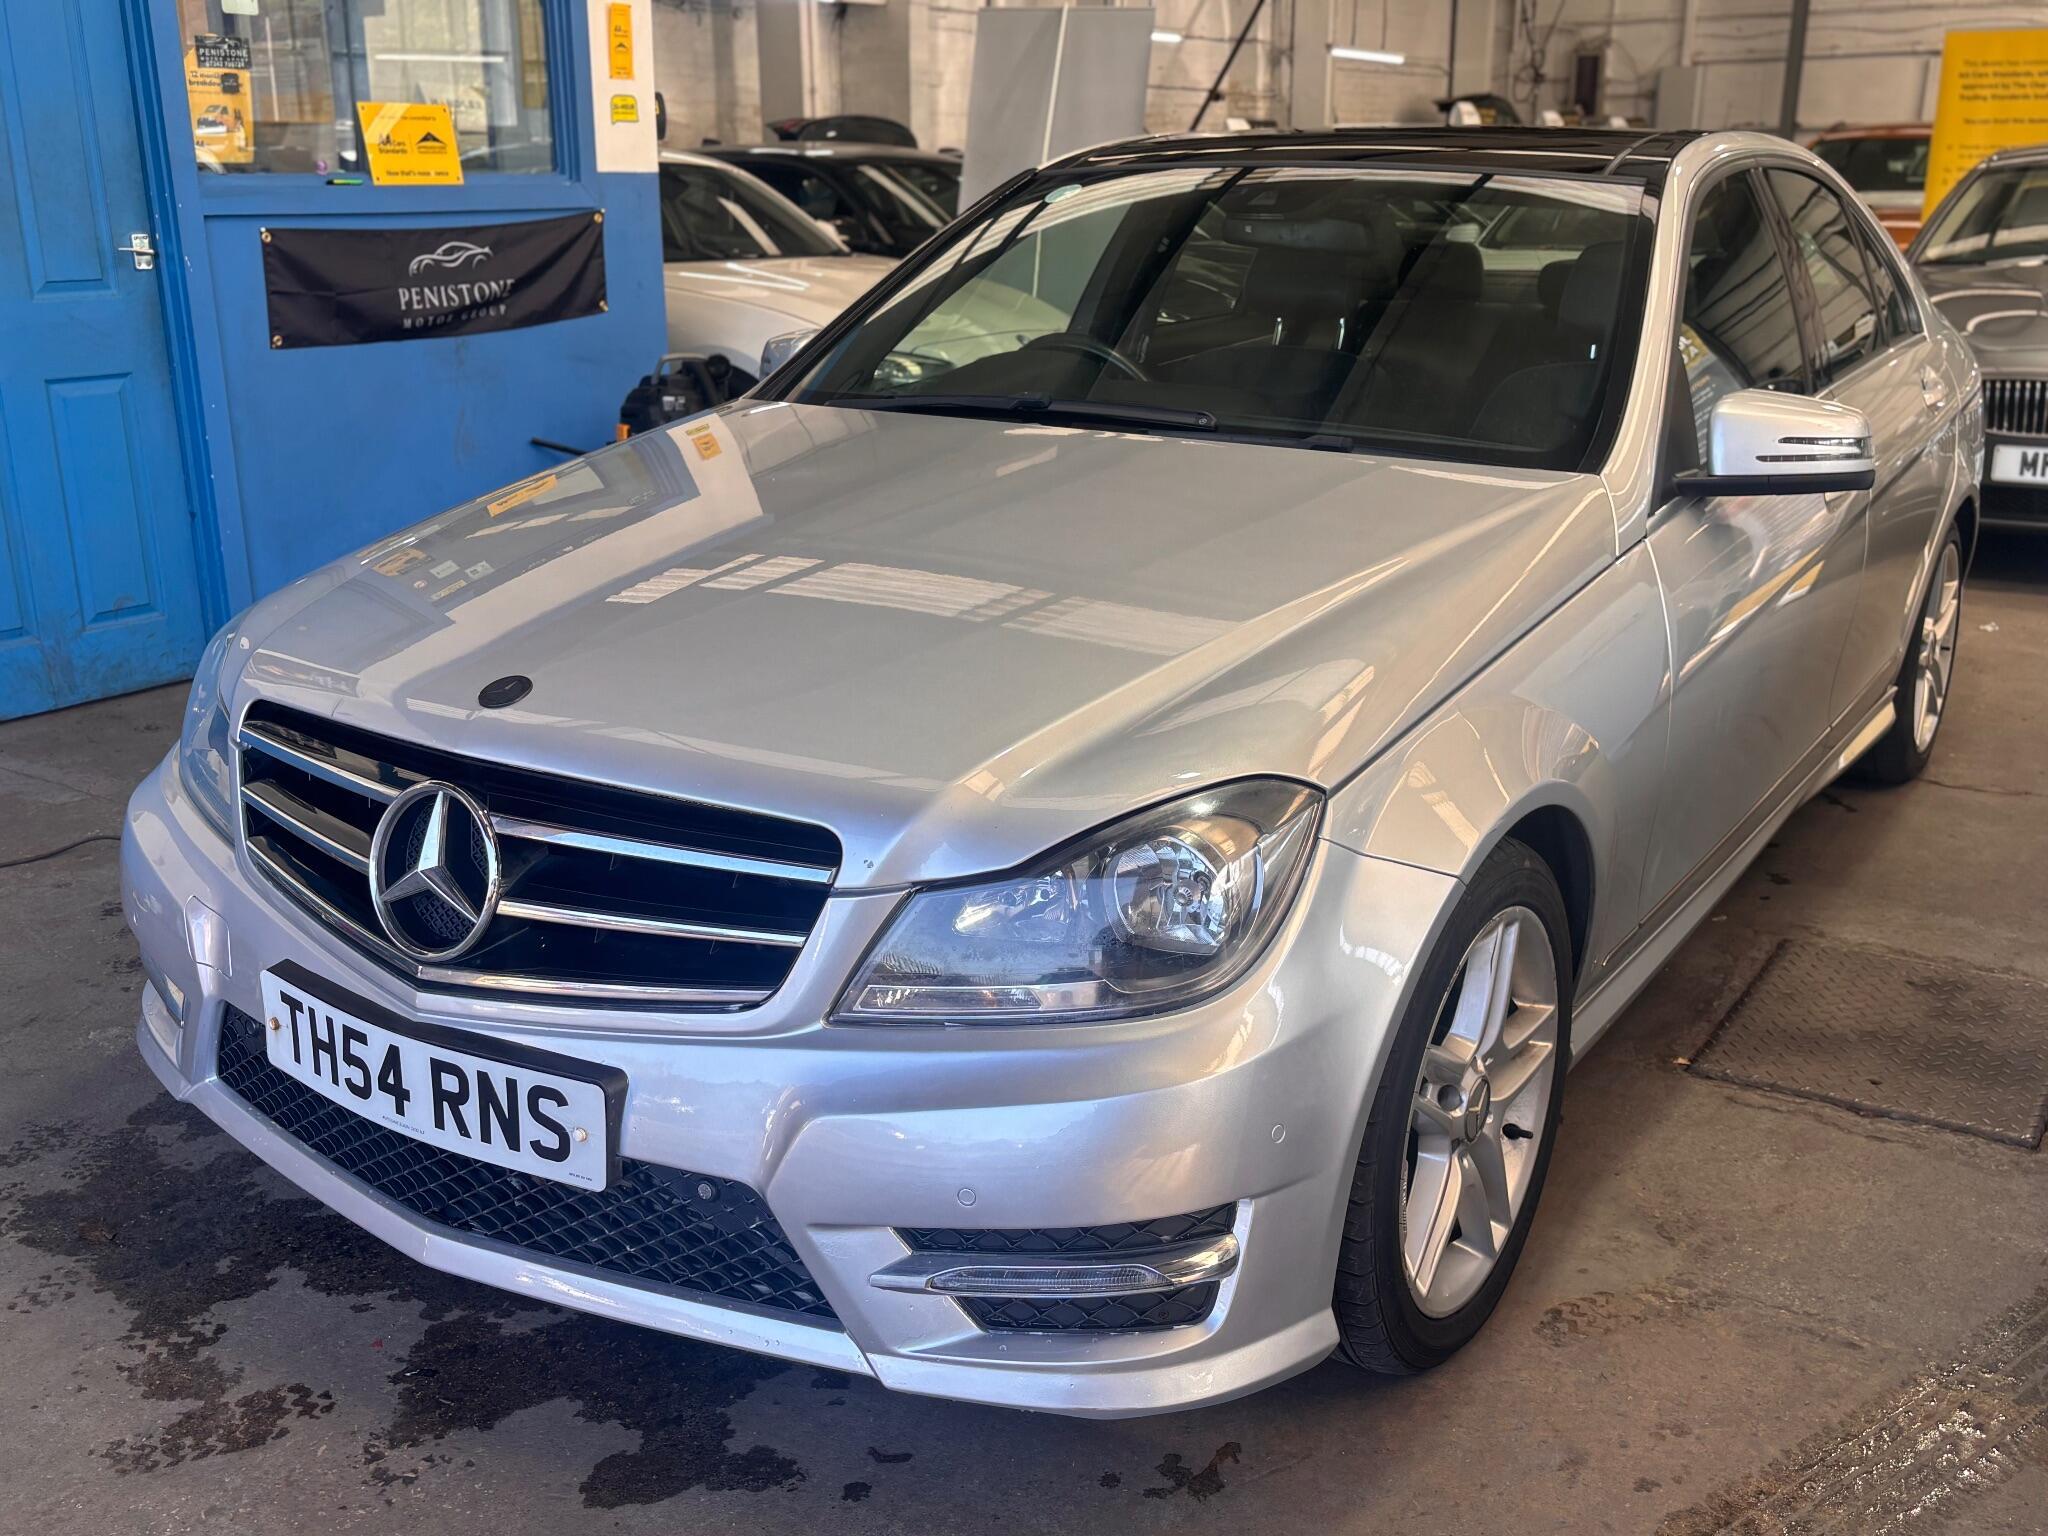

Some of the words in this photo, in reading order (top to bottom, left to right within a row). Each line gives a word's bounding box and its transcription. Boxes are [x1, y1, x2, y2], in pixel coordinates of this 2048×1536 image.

[199, 48, 248, 57] PENISTONE
[399, 279, 515, 310] PENISTONE
[280, 990, 411, 1118] TH54
[430, 1057, 571, 1164] RNS
